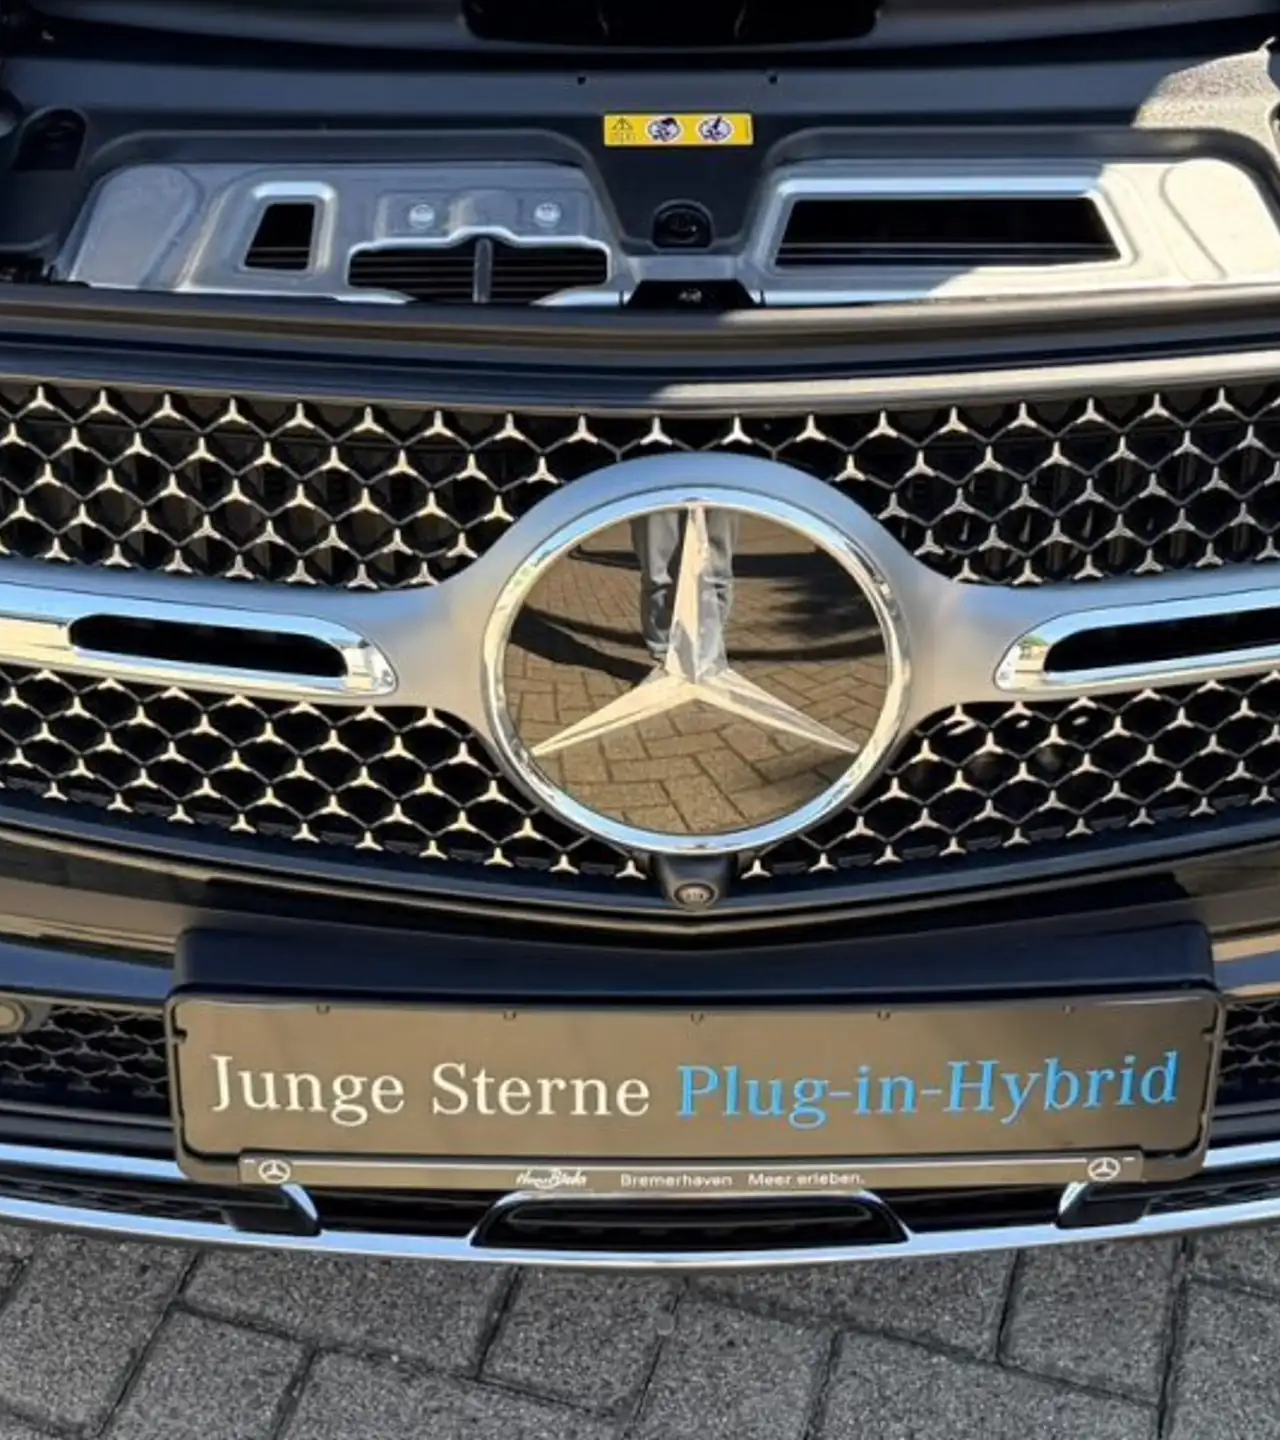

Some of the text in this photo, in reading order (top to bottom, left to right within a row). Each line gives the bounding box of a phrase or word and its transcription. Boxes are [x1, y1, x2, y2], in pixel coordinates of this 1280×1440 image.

[210, 1049, 1182, 1129] Junge Sterne Plug-in-Hybrid
[620, 1172, 734, 1188] Bremerhaven
[748, 1172, 792, 1187] Meer
